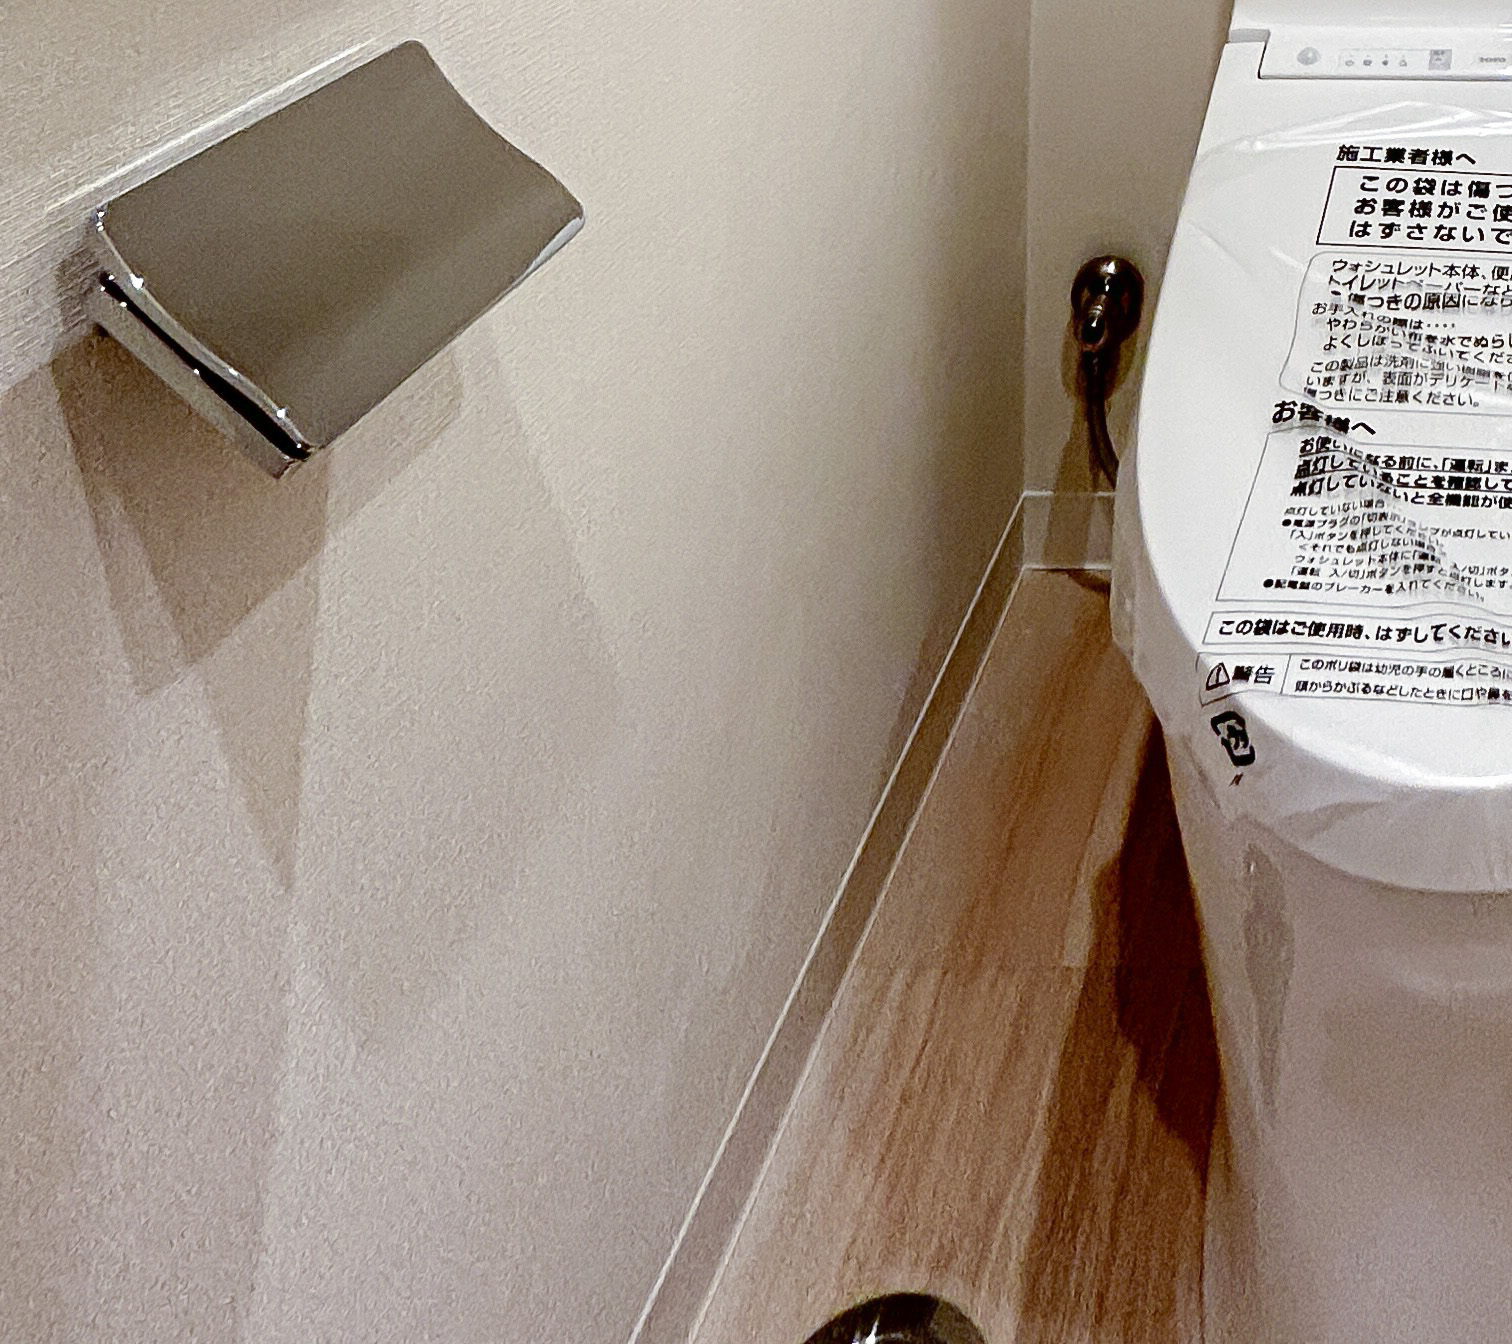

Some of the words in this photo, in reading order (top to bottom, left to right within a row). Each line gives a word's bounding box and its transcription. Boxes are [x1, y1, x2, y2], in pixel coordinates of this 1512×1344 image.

[1336, 144, 1477, 167] 施工業者様へ
[1304, 386, 1480, 408] つきにご注意ください。
[1271, 399, 1377, 436] お客様へ
